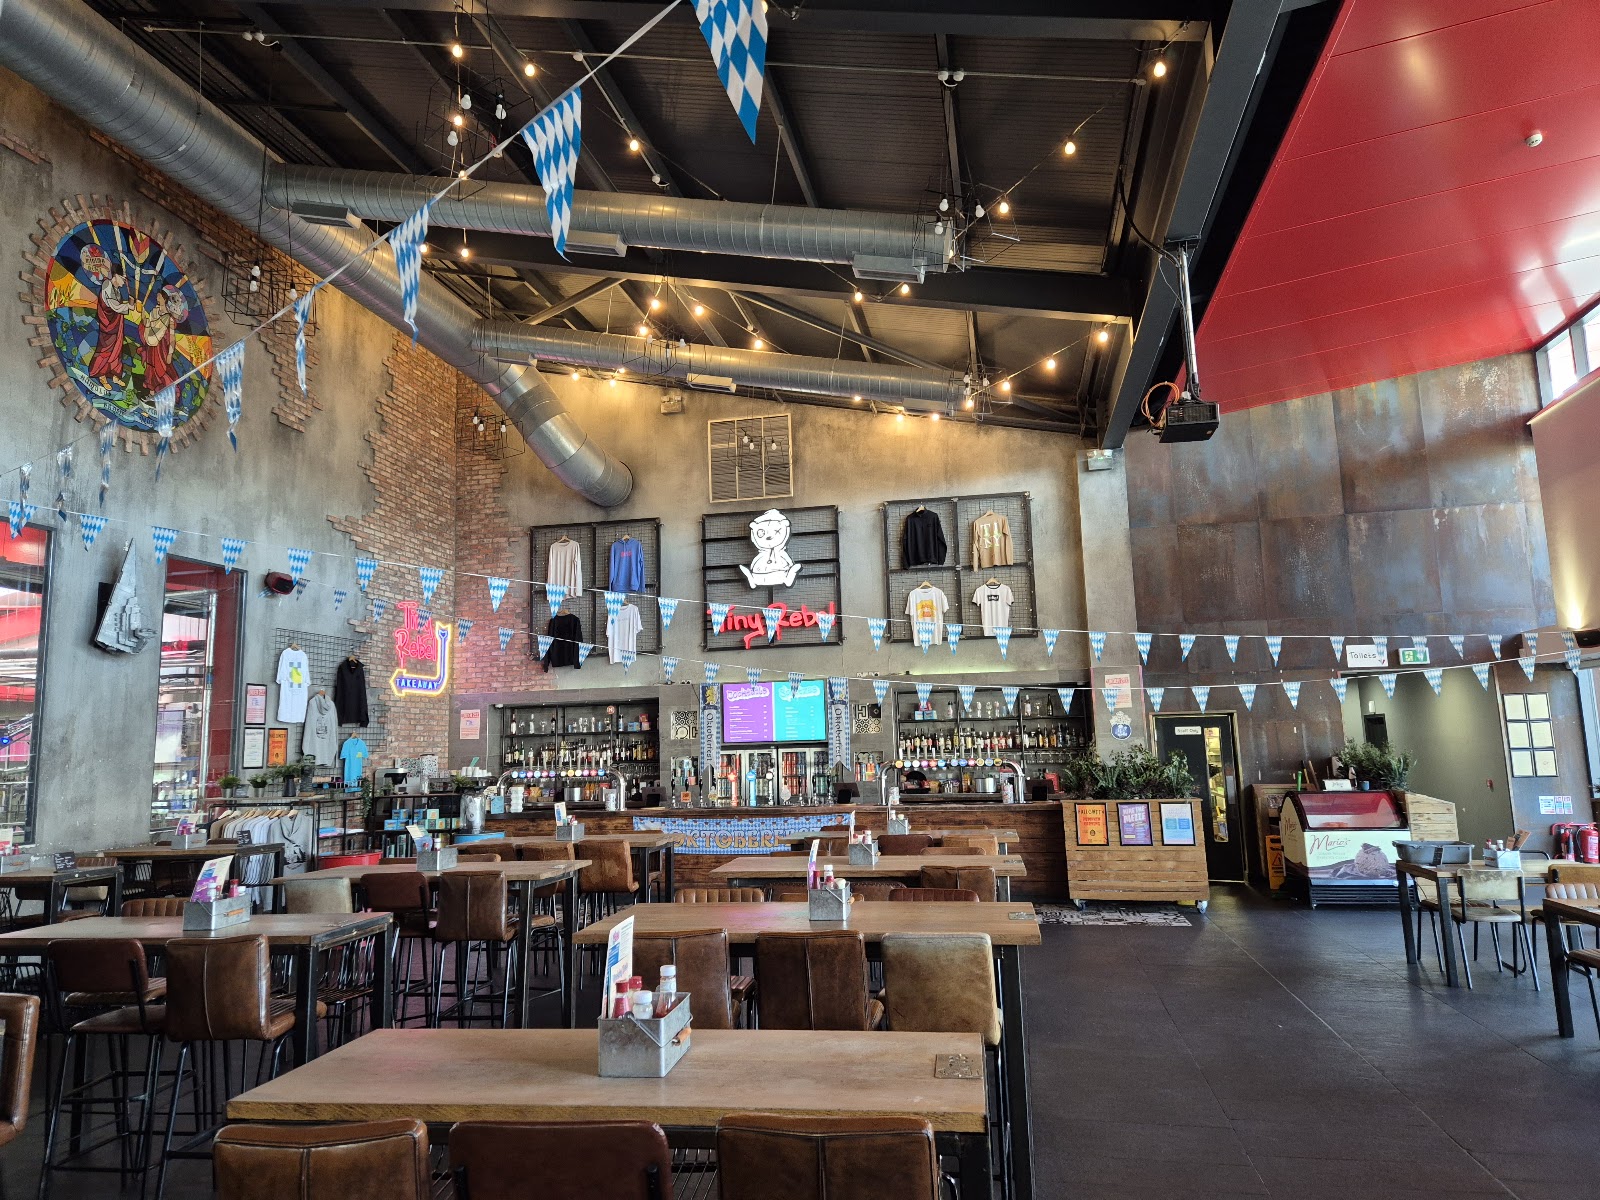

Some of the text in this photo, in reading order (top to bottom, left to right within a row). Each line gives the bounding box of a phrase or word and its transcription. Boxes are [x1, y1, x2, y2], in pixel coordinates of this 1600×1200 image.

[765, 602, 836, 640] Rebl
[394, 628, 437, 669] Rebel
[1349, 651, 1377, 659] Toilets
[396, 678, 438, 690] TAKEAWAY
[834, 708, 843, 758] Oktoberfest
[1309, 834, 1351, 855] Mario's
